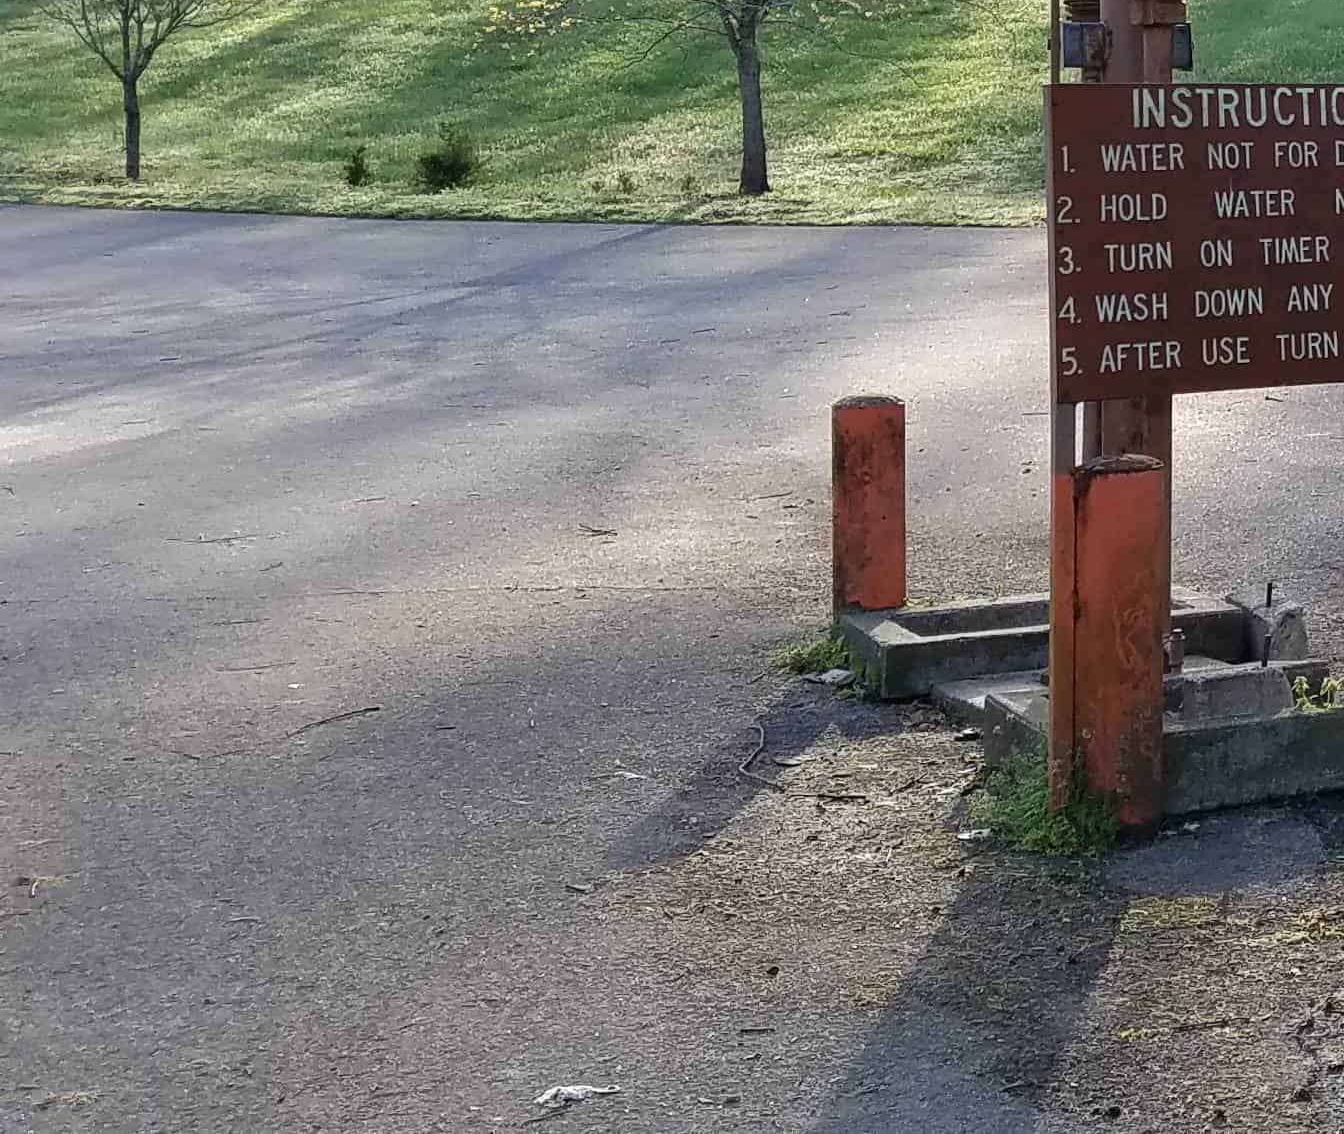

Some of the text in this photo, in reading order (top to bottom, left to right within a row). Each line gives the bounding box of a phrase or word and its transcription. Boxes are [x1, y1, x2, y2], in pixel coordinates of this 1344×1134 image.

[1062, 146, 1075, 172] 1.
[1101, 144, 1184, 171] WATER
[1208, 142, 1253, 169] NOT
[1275, 142, 1317, 167] FOR
[1058, 197, 1080, 223] 2.
[1101, 194, 1166, 221] HOLD
[1215, 190, 1294, 217] WATER
[1059, 247, 1081, 274] 3.
[1104, 242, 1172, 272] TURN
[1201, 240, 1232, 267] ON
[1259, 236, 1329, 264] TIMER
[1058, 297, 1081, 323] 4.
[1096, 293, 1167, 322] WASH
[1196, 288, 1262, 317] DOWN
[1288, 284, 1333, 311] ANY
[1063, 347, 1082, 375] 5.
[1100, 342, 1180, 372] AFTER
[1203, 337, 1250, 365] USE
[1276, 331, 1338, 360] TURN
